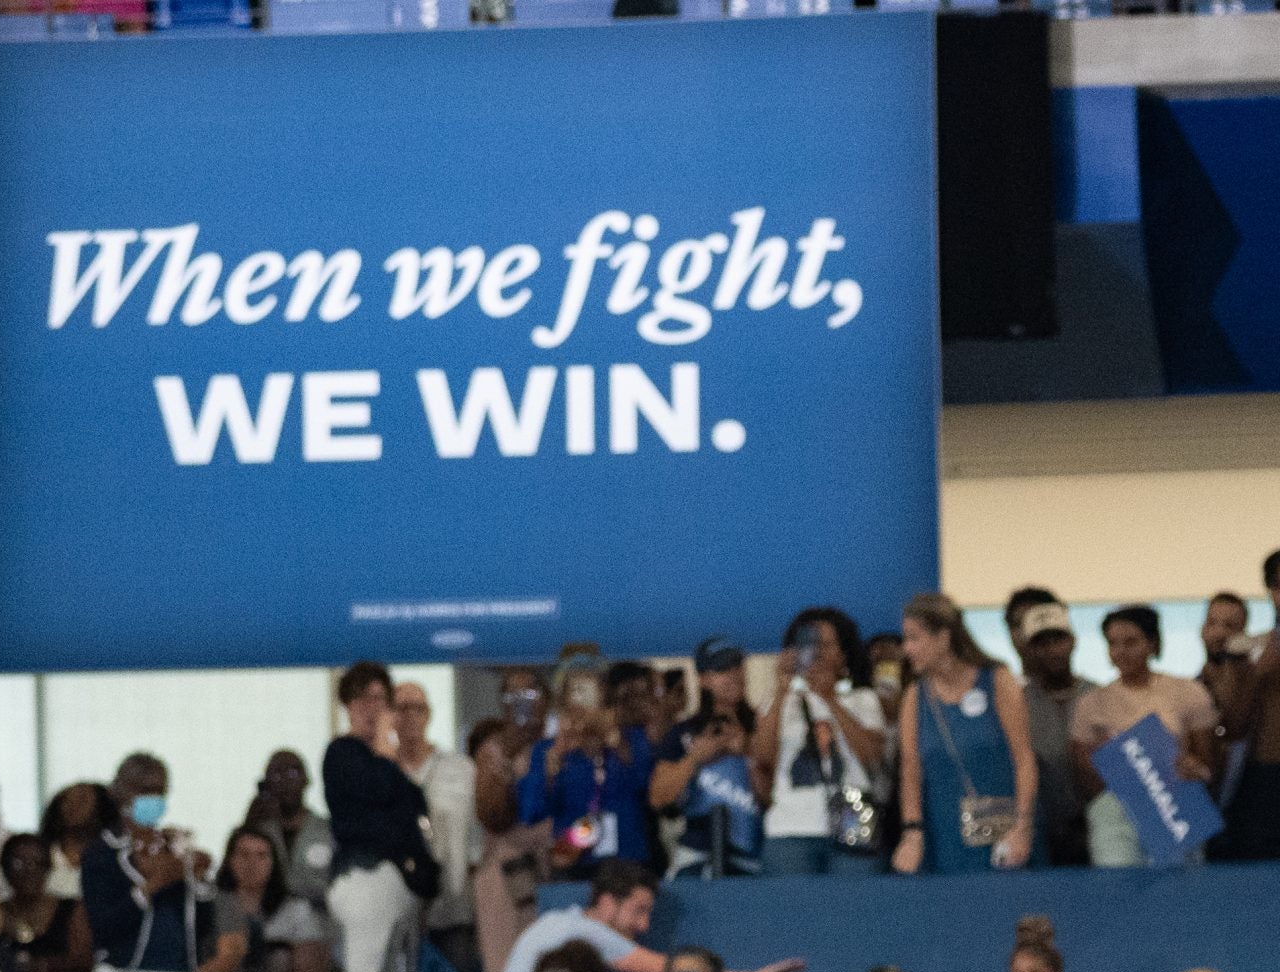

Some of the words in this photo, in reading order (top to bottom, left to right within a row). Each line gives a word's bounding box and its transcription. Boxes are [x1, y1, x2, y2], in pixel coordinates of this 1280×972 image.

[46, 222, 362, 330] When
[383, 243, 541, 320] we
[531, 207, 864, 348] fight,
[153, 369, 383, 466] WE
[415, 361, 747, 459] WIN.
[1122, 737, 1190, 842] KAMALA
